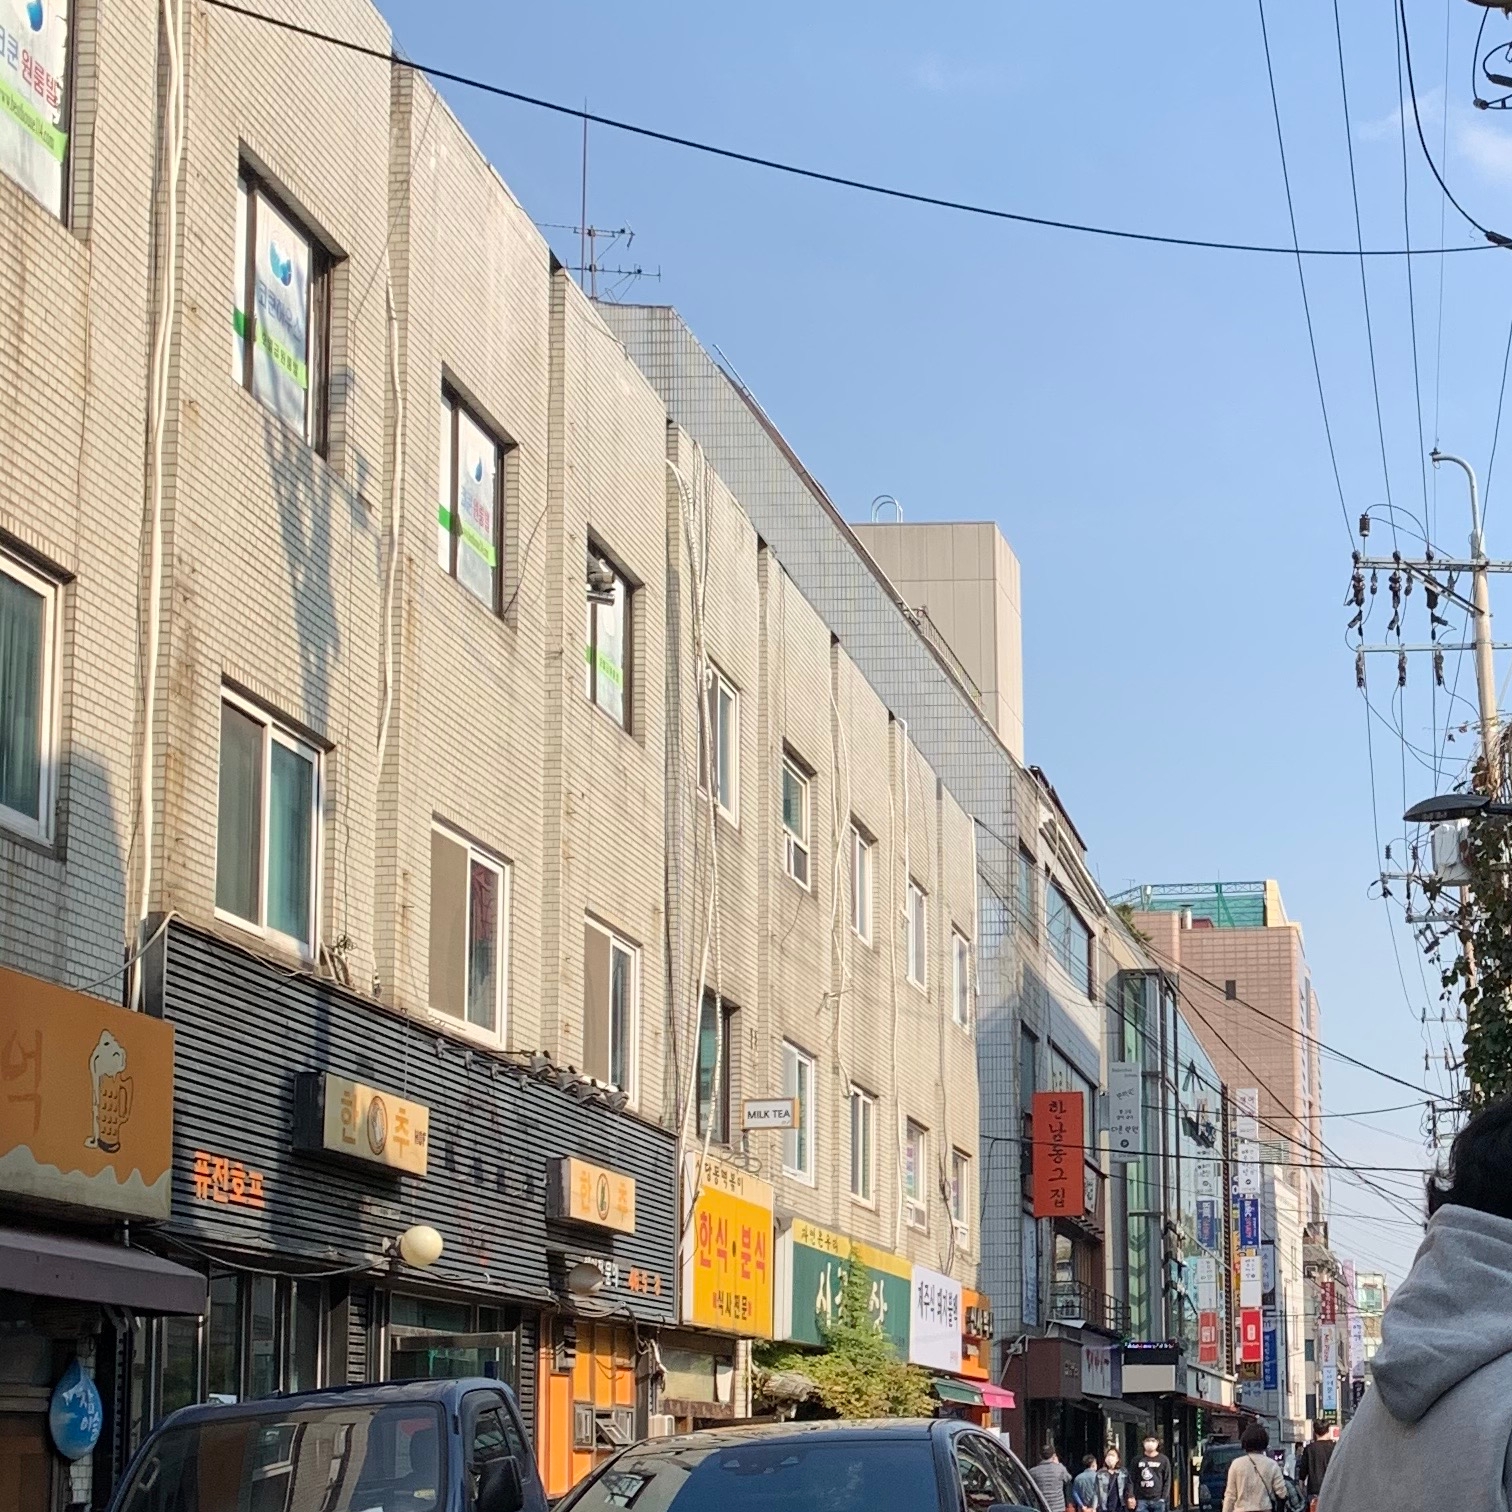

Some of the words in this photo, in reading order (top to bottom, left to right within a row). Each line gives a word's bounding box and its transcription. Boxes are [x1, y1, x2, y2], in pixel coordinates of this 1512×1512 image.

[747, 1110, 770, 1119] MILK
[772, 1109, 791, 1118] TEA
[193, 1150, 265, 1208] 퓨전호프
[1048, 1100, 1068, 1208] 한남동그집
[700, 1211, 728, 1273] 한식
[740, 1224, 766, 1285] 분식
